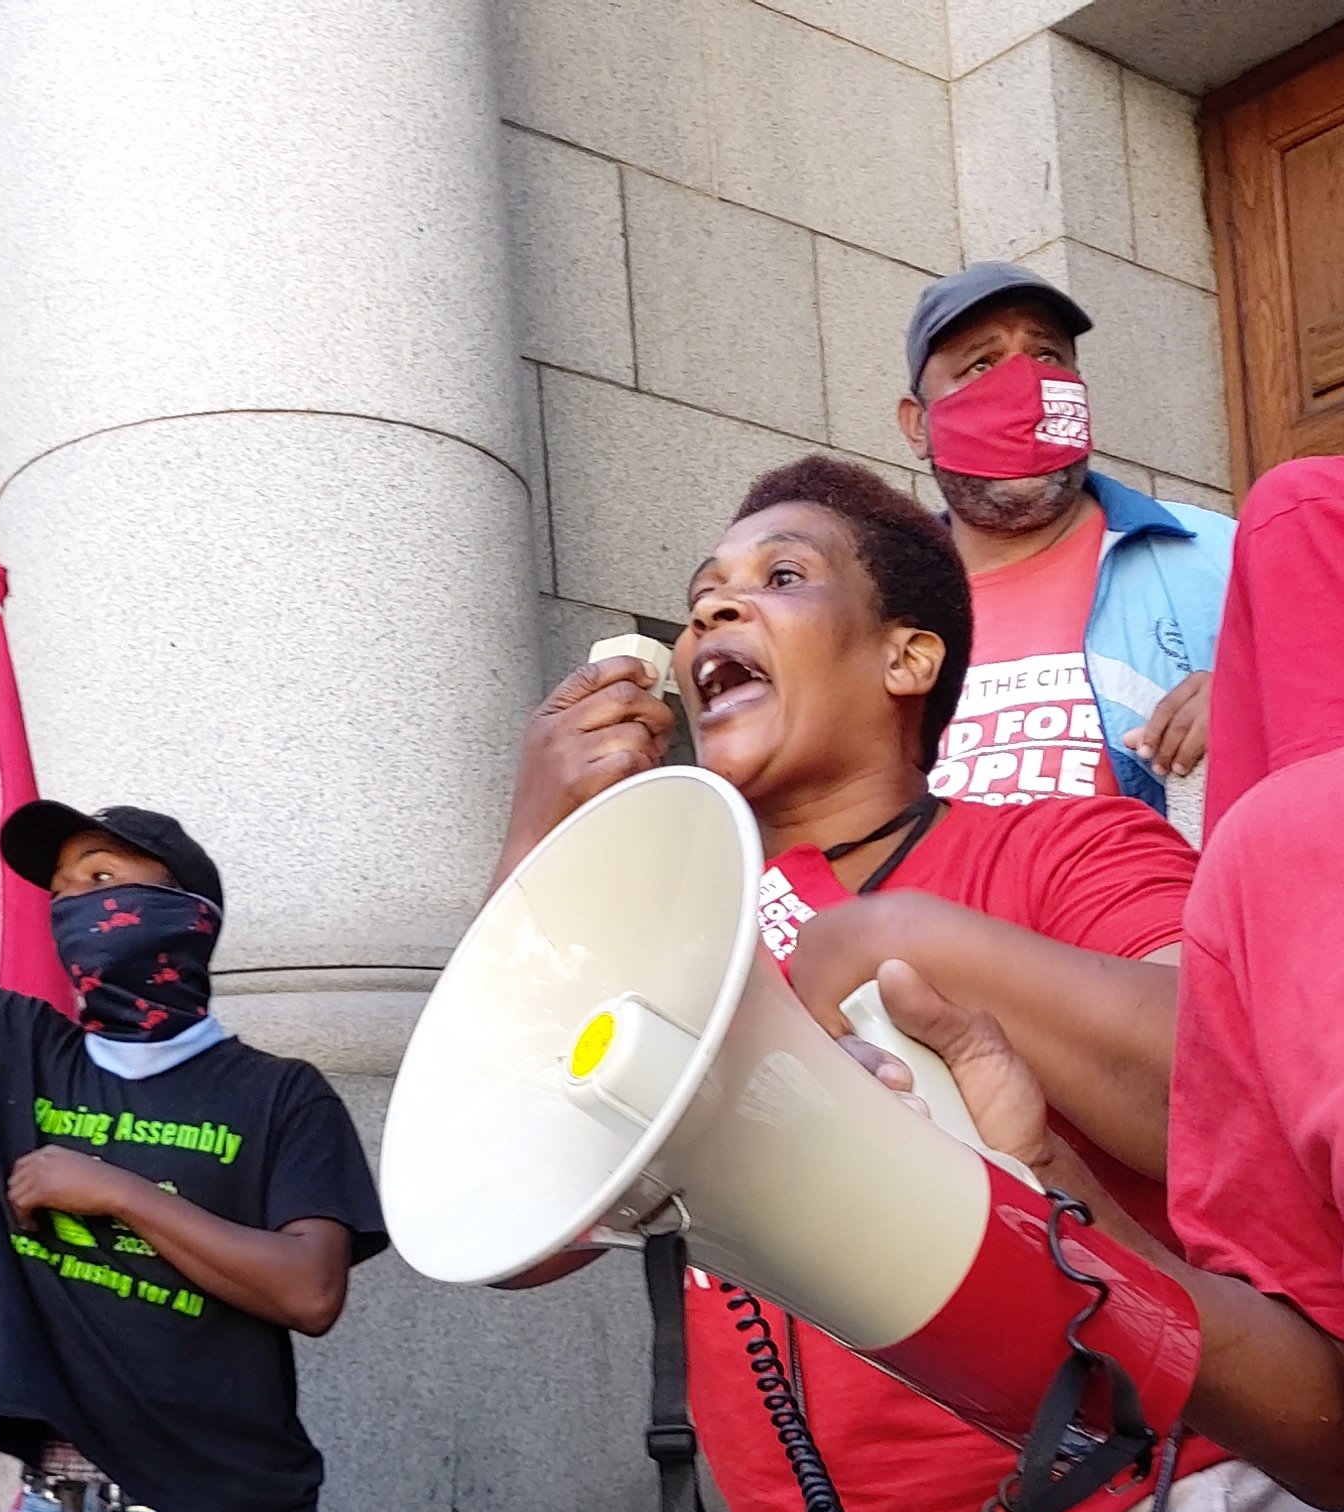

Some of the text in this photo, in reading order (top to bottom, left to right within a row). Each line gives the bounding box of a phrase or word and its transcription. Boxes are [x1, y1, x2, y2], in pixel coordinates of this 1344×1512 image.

[980, 672, 1028, 697] THE
[994, 704, 1104, 744] FOR
[927, 749, 1101, 798] OPLE
[114, 1112, 243, 1164] Assembly
[172, 1289, 204, 1317] All
